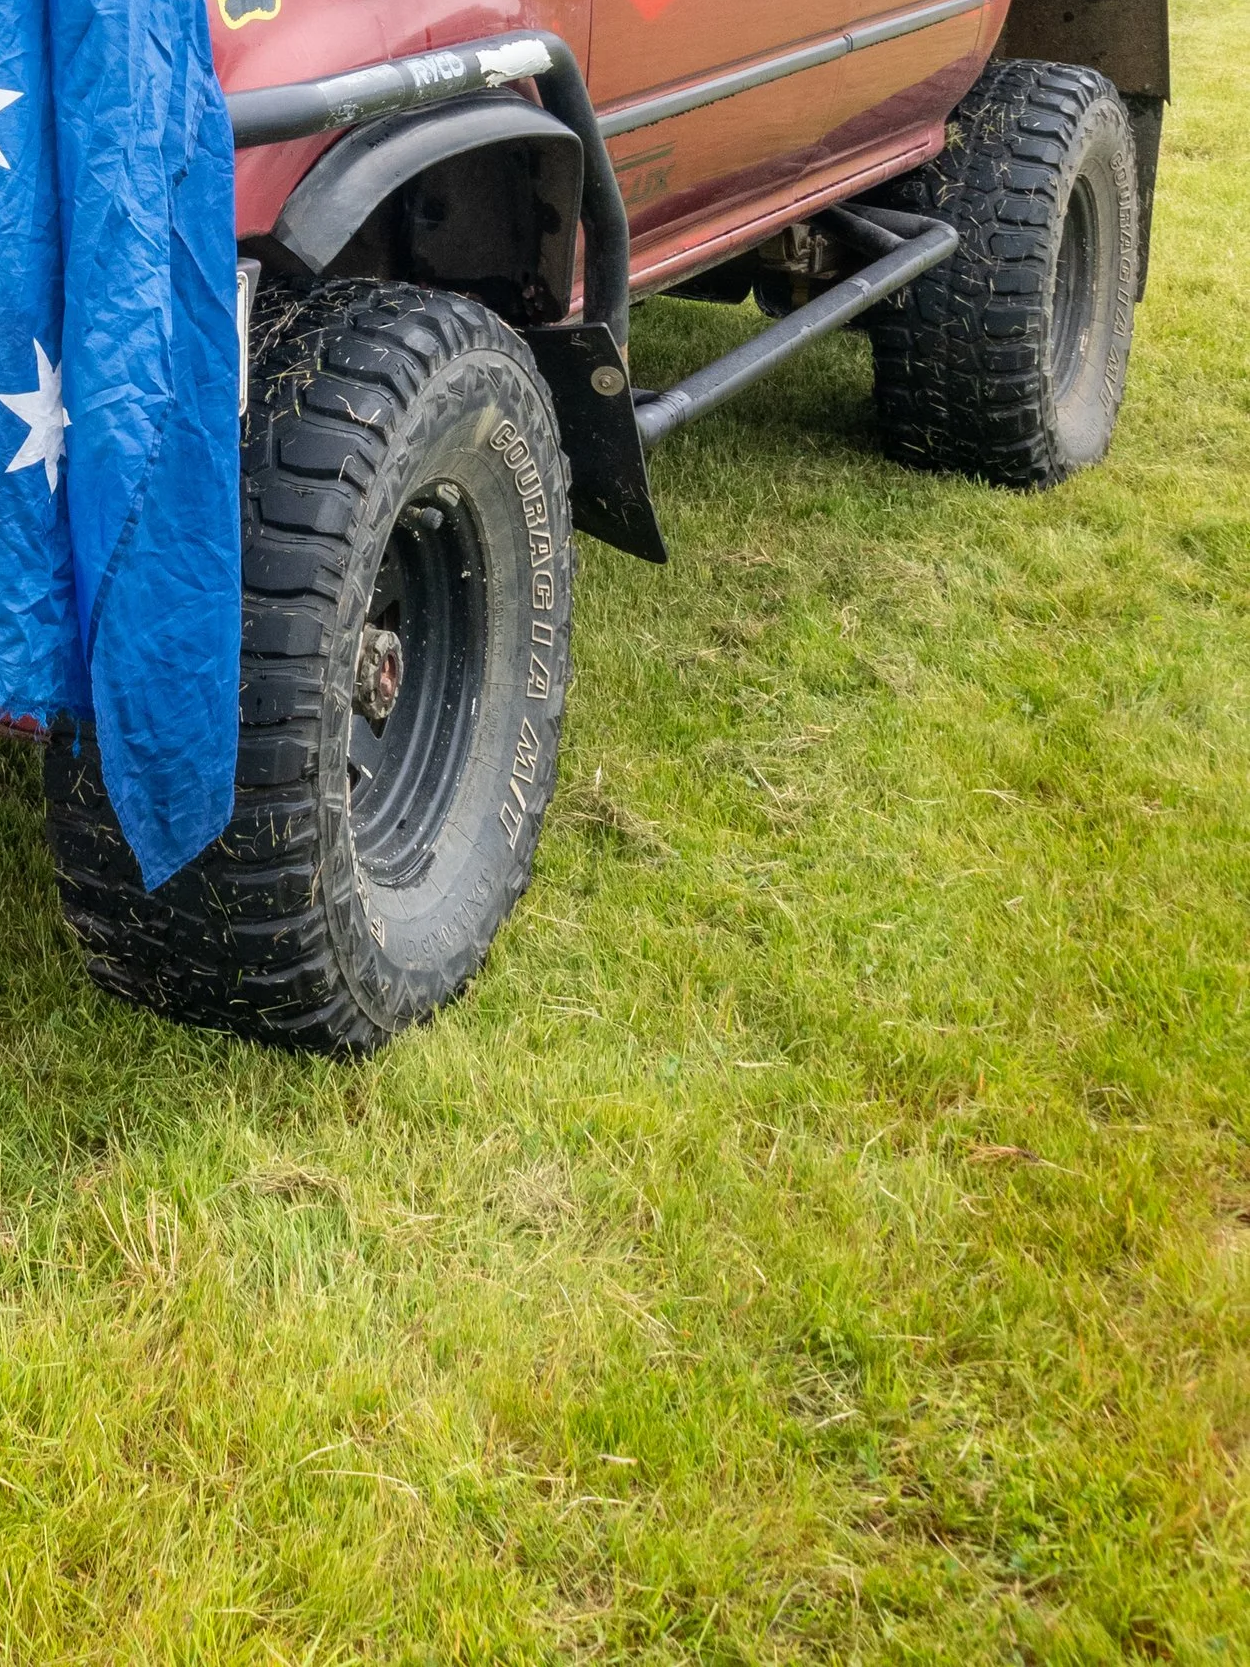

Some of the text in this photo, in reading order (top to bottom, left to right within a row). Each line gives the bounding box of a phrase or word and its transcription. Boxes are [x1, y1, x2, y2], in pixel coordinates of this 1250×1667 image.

[403, 51, 466, 87] RYCO
[489, 419, 553, 851] COURAGIA M/T
